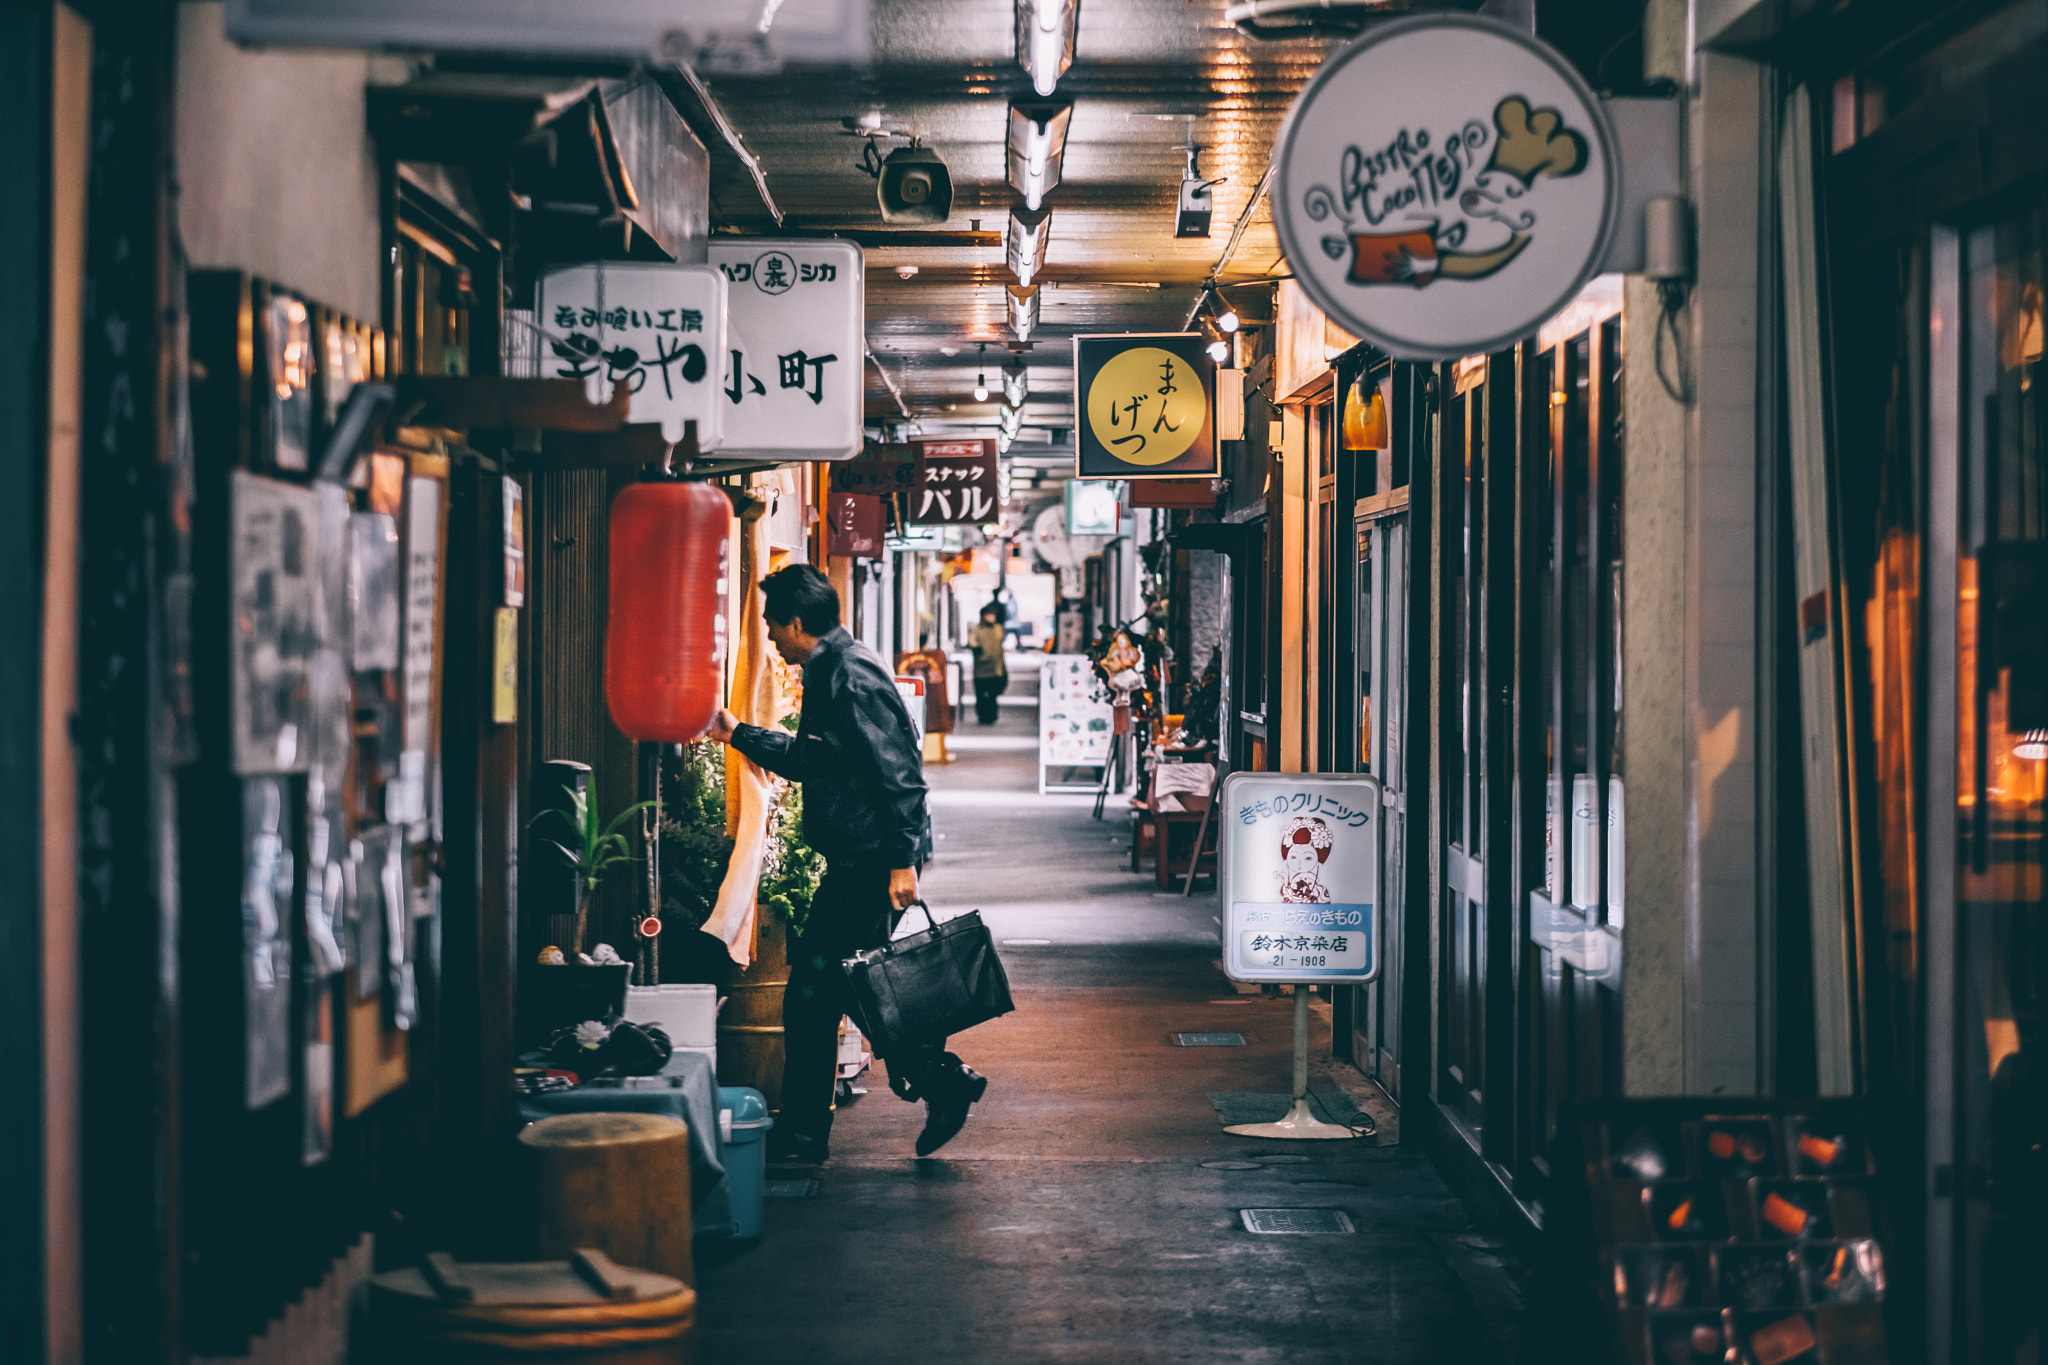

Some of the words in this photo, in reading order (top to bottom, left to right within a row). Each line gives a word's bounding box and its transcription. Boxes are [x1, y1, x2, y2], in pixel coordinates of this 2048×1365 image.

[799, 264, 836, 283] シカ
[724, 350, 838, 405] 小町
[1151, 358, 1186, 434] まん
[1111, 394, 1149, 455] げつ
[924, 464, 985, 483] スナック
[918, 486, 993, 520] バル
[1239, 793, 1369, 828] きものクリニック
[1250, 934, 1348, 952] 鈴木京染店
